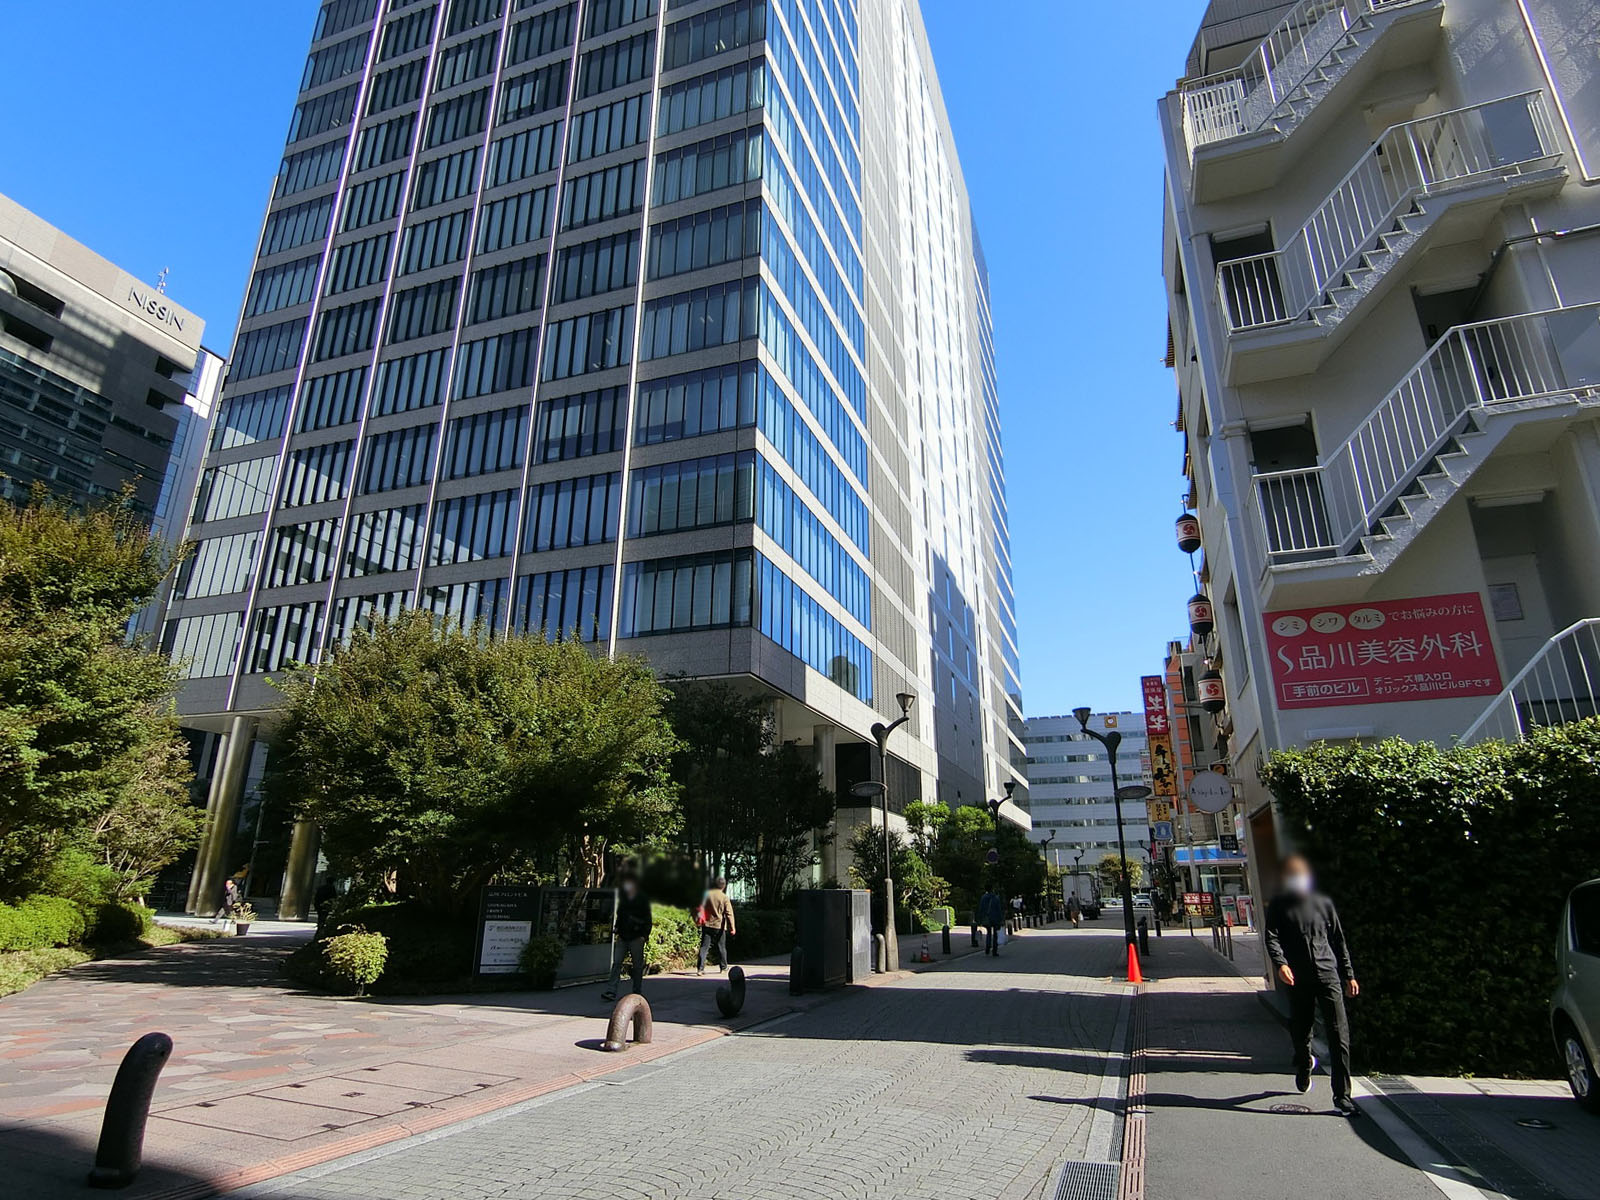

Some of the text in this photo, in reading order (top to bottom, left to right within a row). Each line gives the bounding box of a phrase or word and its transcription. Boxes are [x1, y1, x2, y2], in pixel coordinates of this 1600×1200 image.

[128, 287, 184, 331] NISSIN
[1352, 613, 1383, 624] タルミ
[1387, 604, 1475, 622] でお悩みの方に
[1279, 620, 1301, 631] シミ
[1316, 616, 1339, 628] シワ
[1298, 630, 1483, 671] 品川美容外科
[1292, 682, 1361, 699] 手前のビル
[1375, 678, 1492, 695] オリックス品川ビル9Fです
